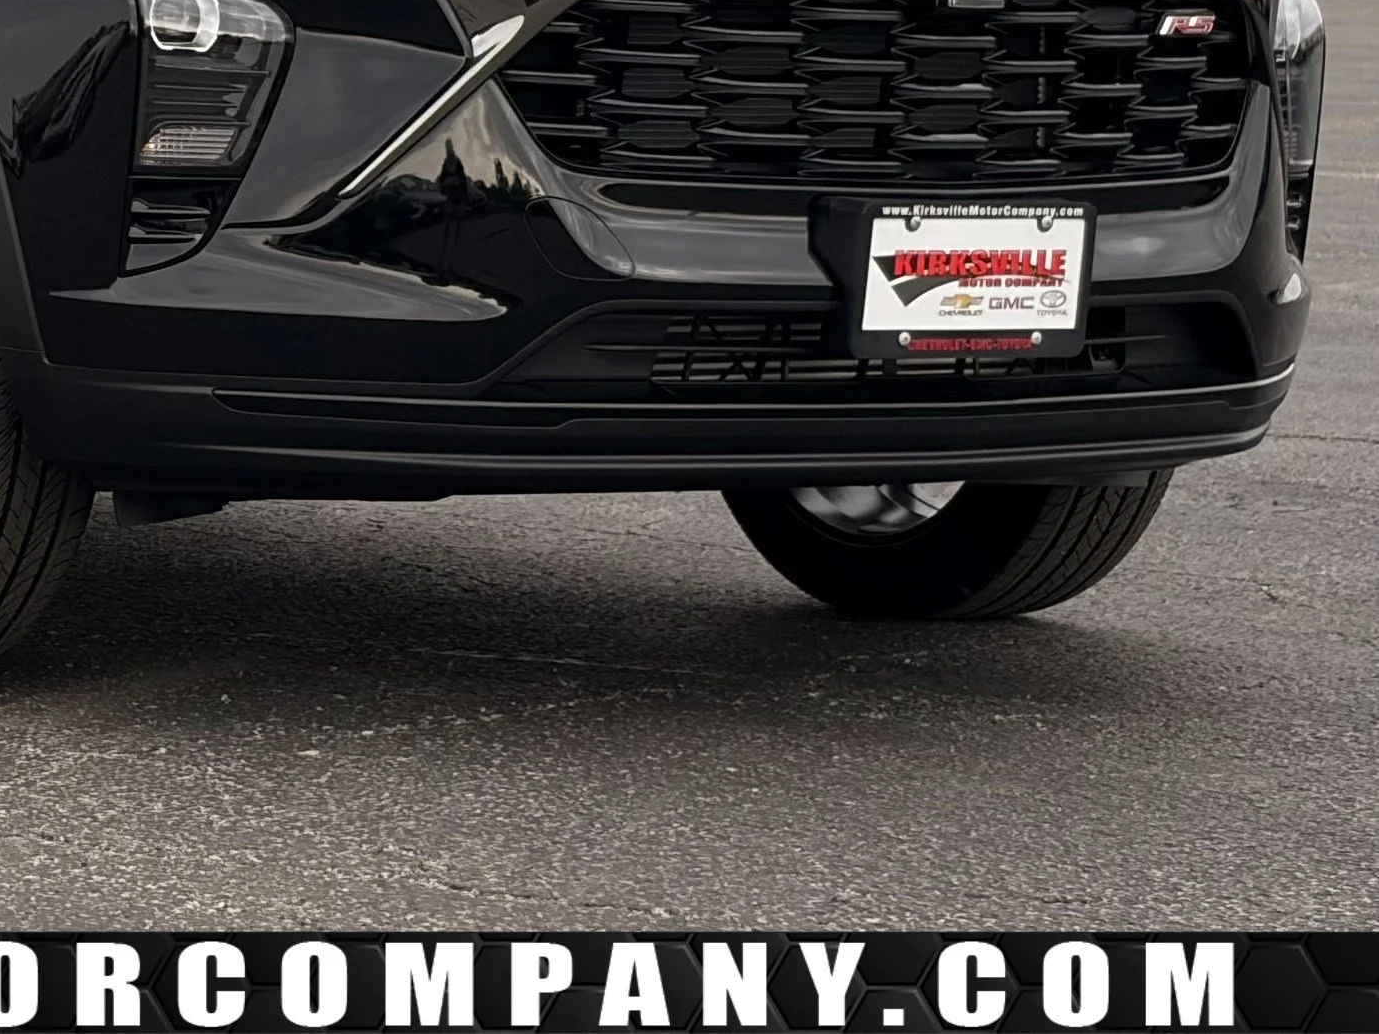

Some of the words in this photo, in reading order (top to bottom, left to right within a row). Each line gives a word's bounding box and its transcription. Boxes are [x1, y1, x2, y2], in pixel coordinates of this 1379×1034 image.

[1158, 13, 1217, 36] RS
[881, 204, 1085, 218] www.KirksvilleMotorCompany.com
[893, 249, 1067, 277] KIRKSVILLE
[958, 277, 1002, 288] MOTOR
[1004, 277, 1064, 288] COMPANY
[988, 296, 1036, 310] GMC
[938, 309, 984, 317] CHEVROLET
[1036, 309, 1069, 317] TOYOTA
